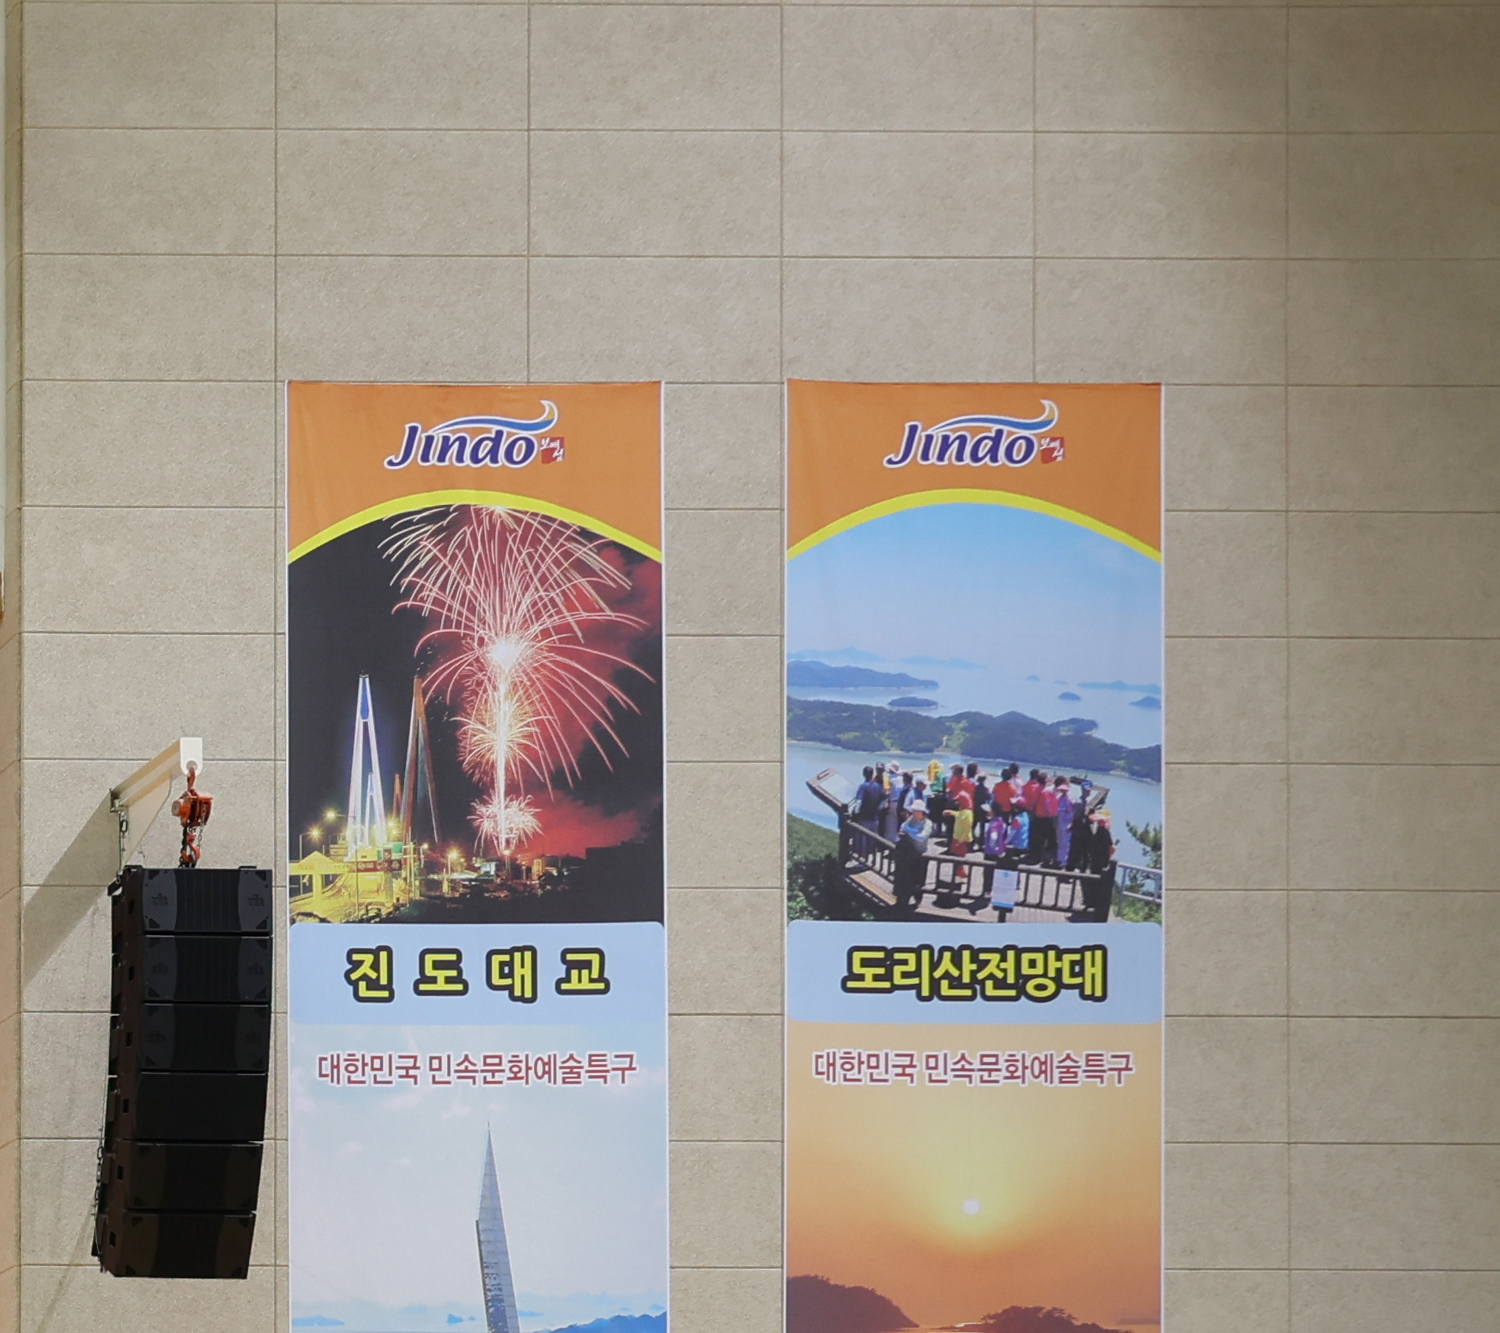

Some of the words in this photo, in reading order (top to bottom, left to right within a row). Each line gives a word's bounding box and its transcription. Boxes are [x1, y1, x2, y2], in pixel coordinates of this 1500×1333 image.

[384, 421, 537, 469] Jindo
[884, 421, 1037, 468] Jindo
[843, 944, 1107, 1001] 도리산전망대
[316, 1052, 422, 1087] 대한민국
[427, 1051, 638, 1088] 민속문화예술특구
[814, 1050, 917, 1085] 대한민국
[925, 1049, 1134, 1087] 민속문화예술특구
